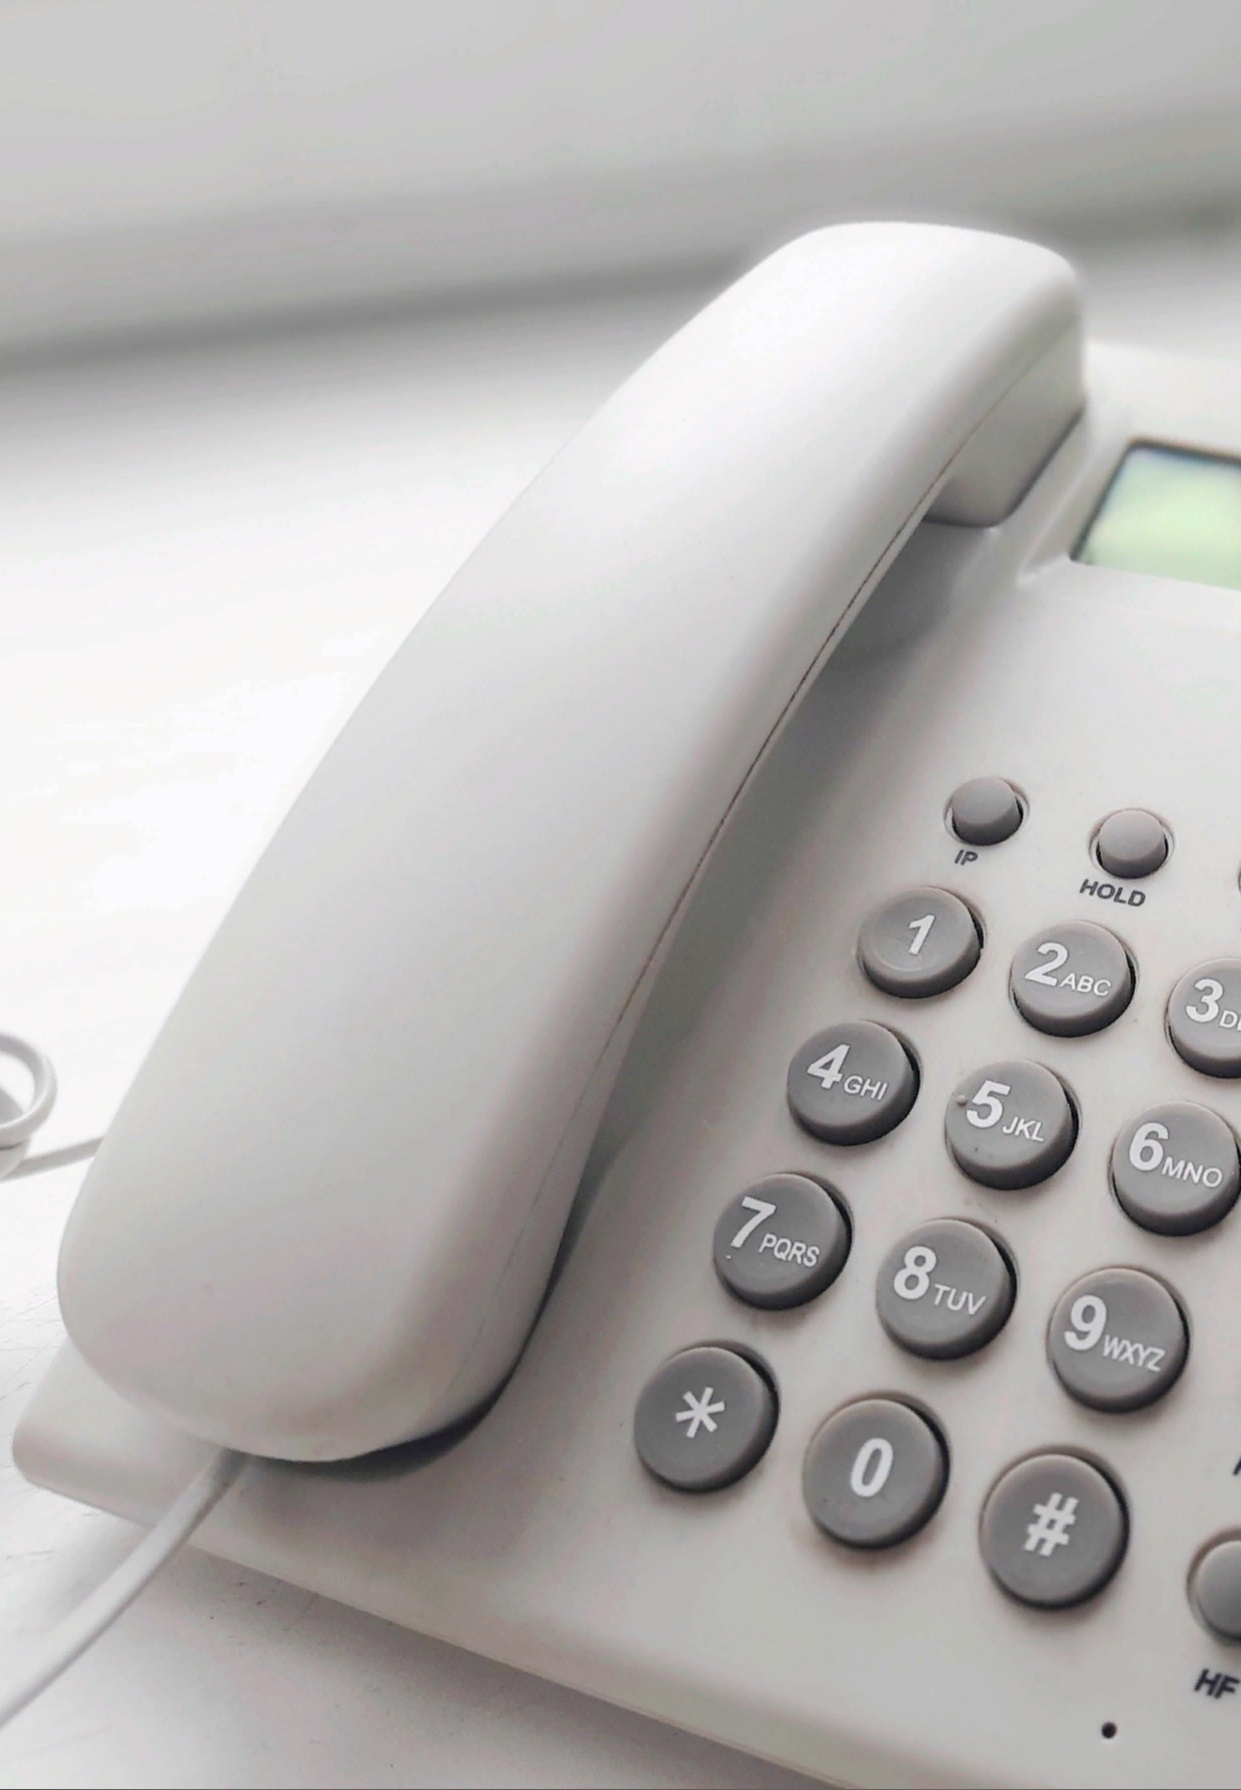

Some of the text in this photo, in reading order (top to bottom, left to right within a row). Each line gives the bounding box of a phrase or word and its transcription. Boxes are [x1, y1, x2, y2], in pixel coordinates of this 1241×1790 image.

[954, 849, 978, 866] IP
[1080, 878, 1146, 907] HOLD
[908, 914, 935, 956] 1
[849, 1437, 893, 1497] 0
[1194, 1669, 1241, 1699] HF
